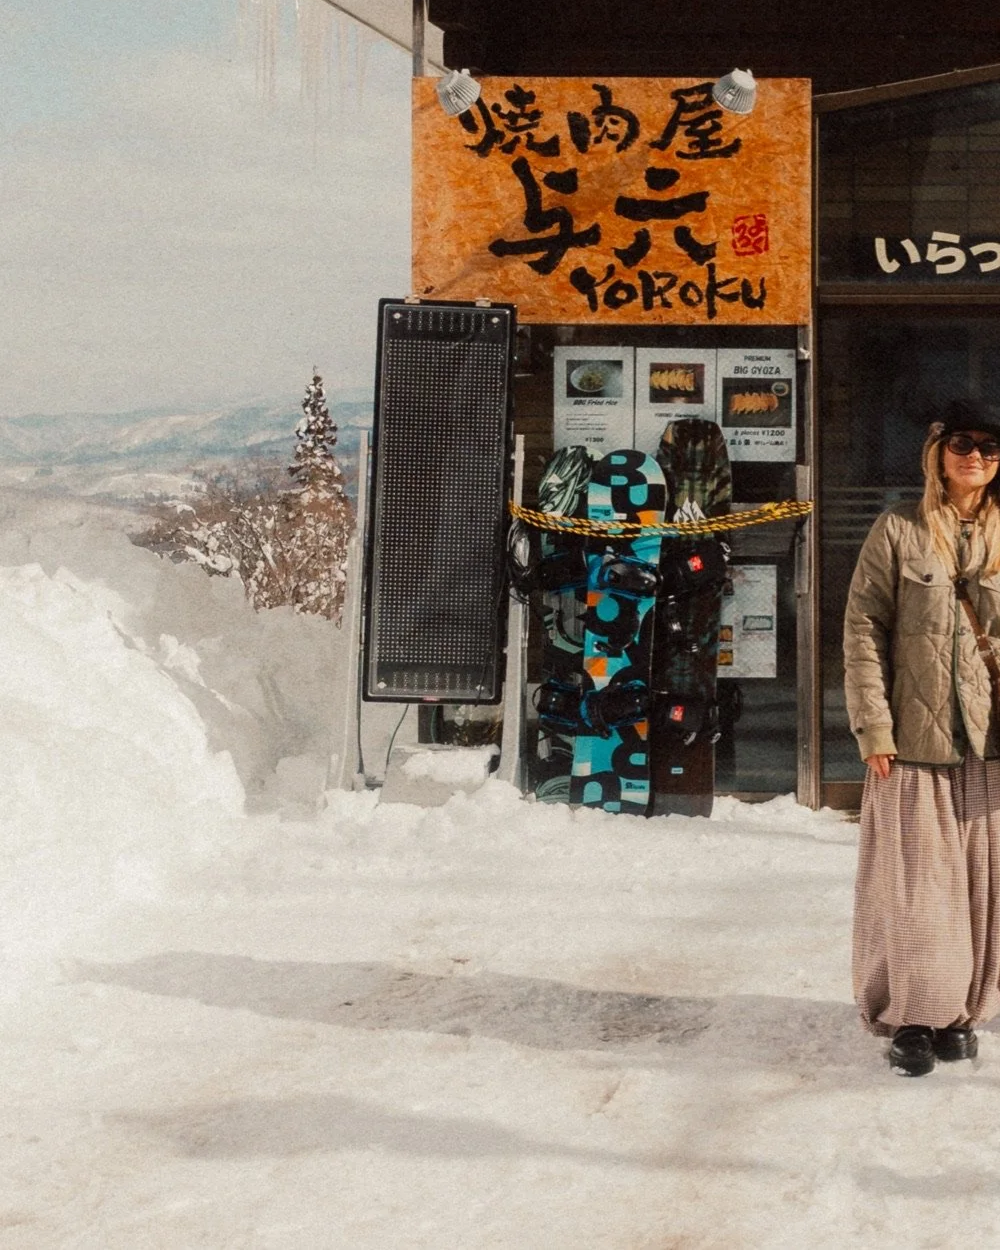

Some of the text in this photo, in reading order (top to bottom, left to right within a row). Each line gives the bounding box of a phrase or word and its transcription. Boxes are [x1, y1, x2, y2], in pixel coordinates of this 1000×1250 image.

[459, 82, 742, 160] 焼肉屋
[488, 156, 717, 275] 与六
[733, 365, 781, 375] BIG GYOZA
[762, 429, 786, 437] ¥1200
